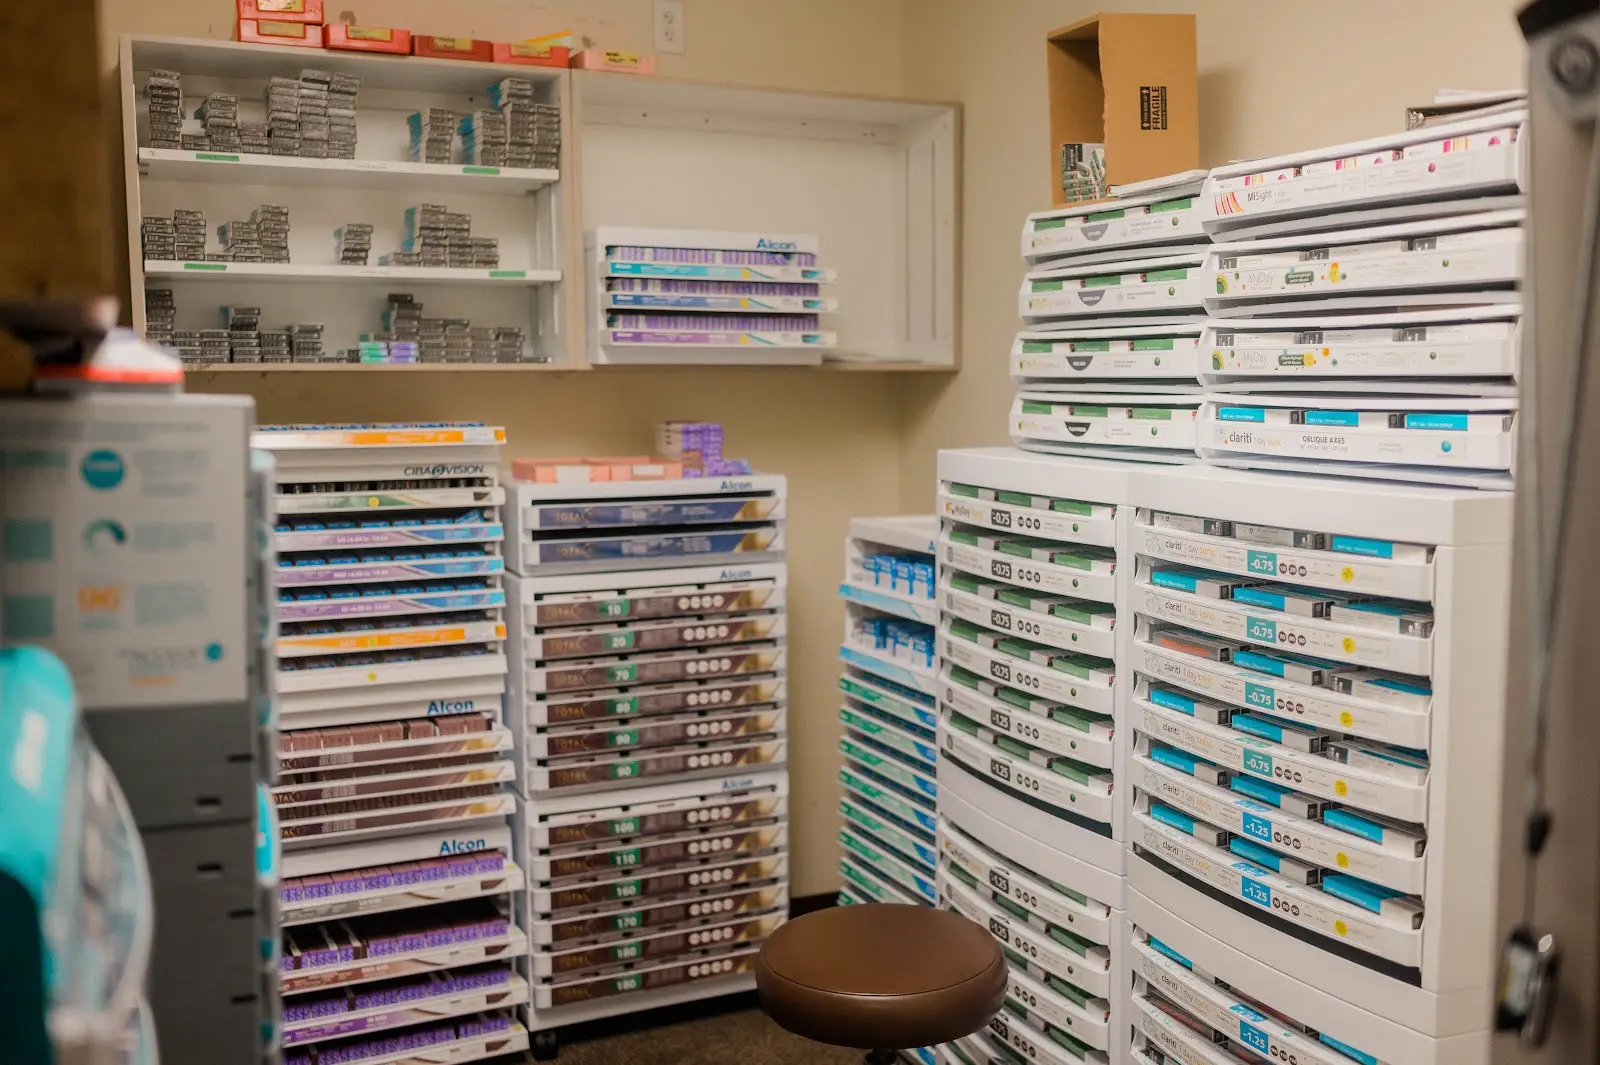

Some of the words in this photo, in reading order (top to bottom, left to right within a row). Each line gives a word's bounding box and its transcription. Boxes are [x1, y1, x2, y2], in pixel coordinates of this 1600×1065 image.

[1152, 86, 1160, 130] FRAGILE
[1248, 190, 1272, 202] MiSight
[756, 238, 797, 250] Alcon
[1243, 351, 1268, 366] MyDay
[1230, 431, 1252, 444] clariti
[1302, 435, 1328, 444] OBLIQUE
[444, 463, 484, 474] VISION
[720, 480, 752, 491] Alcon
[992, 511, 1010, 525] -0.75
[1164, 539, 1183, 552] clariti
[992, 562, 1010, 576] -0.75
[1250, 558, 1274, 572] -0.75
[720, 570, 752, 580] Alcon
[607, 604, 621, 616] 10
[1165, 600, 1182, 613] clariti
[992, 612, 1010, 627] -0.75
[1250, 626, 1273, 639] -0.75
[612, 636, 626, 649] 20
[616, 670, 630, 681] 70
[992, 664, 1010, 679] -0.75
[1164, 662, 1181, 675] clariti
[1248, 692, 1272, 706] -0.75
[428, 700, 474, 714] Alcon
[1162, 722, 1180, 736] clariti
[1246, 758, 1270, 774] -0.75
[1162, 782, 1180, 796] clariti
[614, 822, 635, 834] 100
[1246, 822, 1269, 838] -1.25
[440, 838, 486, 854] Alcon
[1162, 842, 1179, 856] clariti
[616, 853, 636, 866] 110
[1244, 886, 1268, 902] -1.25
[616, 916, 638, 929] 170
[1161, 974, 1178, 991] clariti
[1161, 1032, 1177, 1048] clariti
[1242, 1032, 1266, 1050] -1.25
